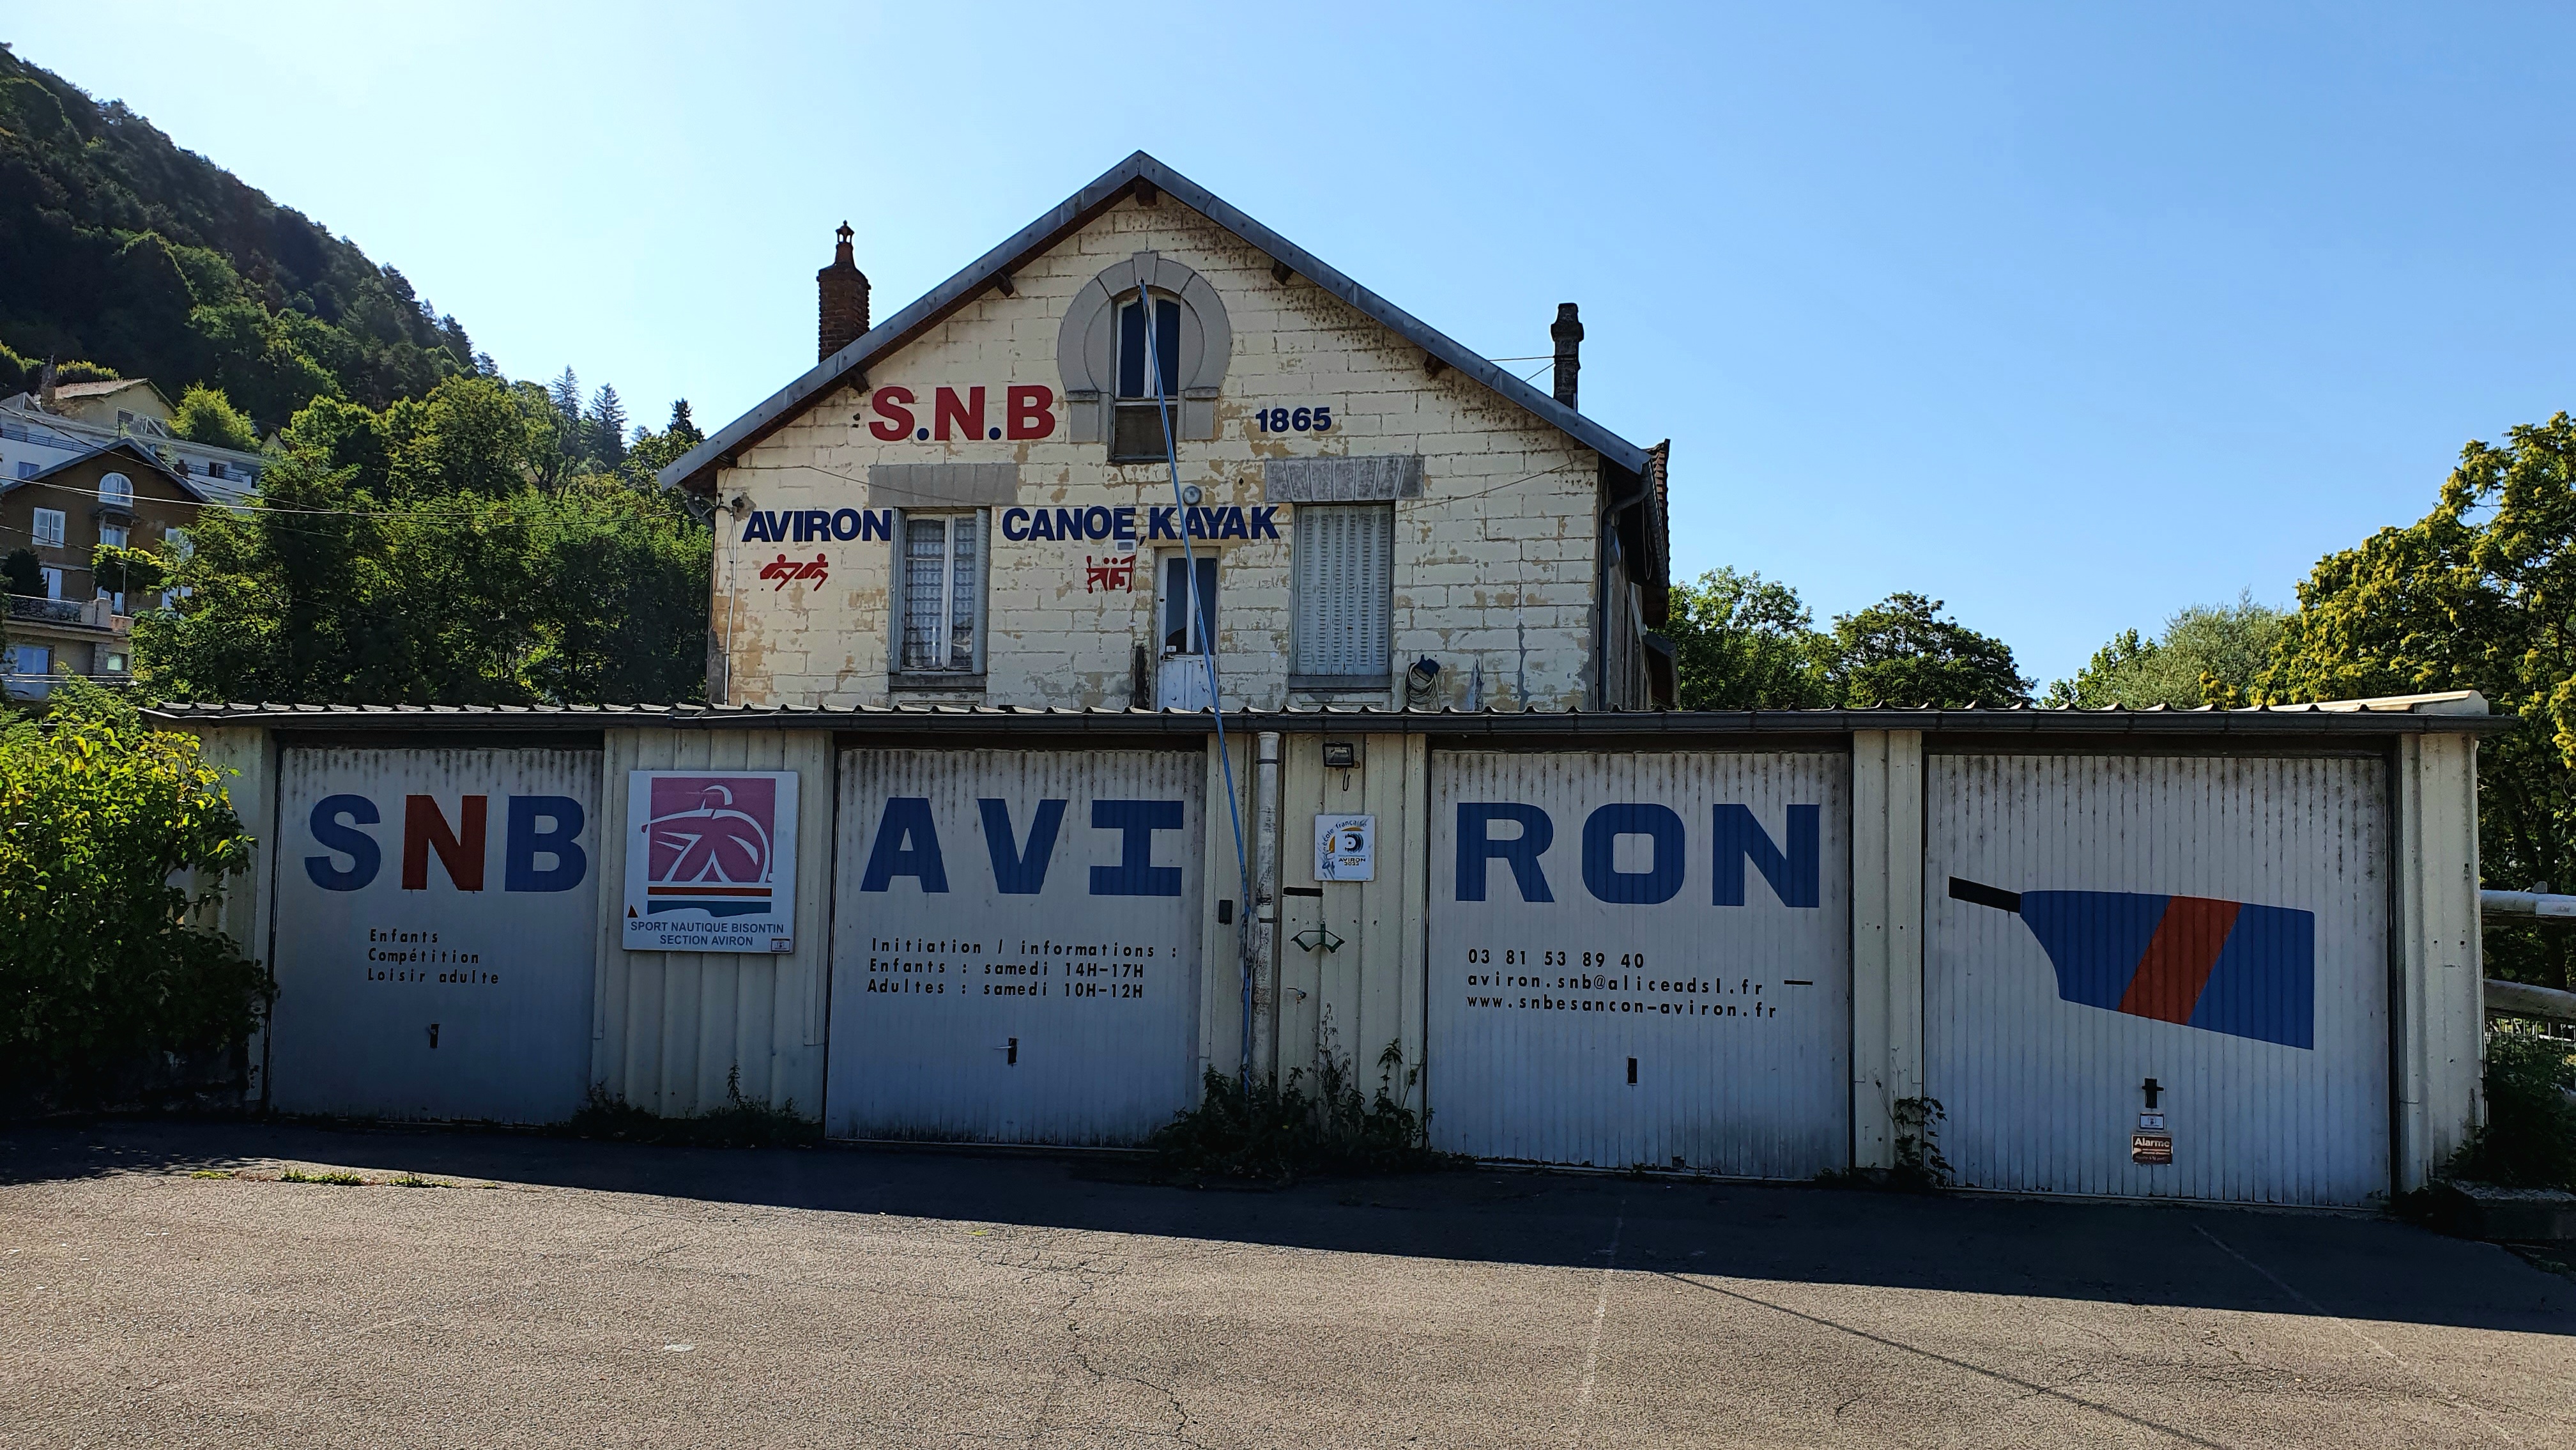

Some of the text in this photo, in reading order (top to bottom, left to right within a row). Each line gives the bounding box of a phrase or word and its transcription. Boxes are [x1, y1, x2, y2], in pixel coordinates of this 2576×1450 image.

[869, 385, 1055, 442] S.N.B
[1255, 406, 1332, 433] 1865
[741, 508, 893, 542] AVIRON
[370, 928, 438, 943] Enfants
[631, 922, 784, 934] SPORT NAUTIQUE BISONTIN
[660, 935, 753, 946] SECTION AVIRON
[872, 937, 981, 954] Initiation
[1021, 940, 1154, 957] informations
[368, 947, 479, 965] Compétition
[1468, 948, 1644, 968] 03 81 53 89 40
[367, 968, 499, 984] Loisir adulte
[870, 958, 946, 974] Enfants
[985, 960, 1048, 976] samedi
[1065, 962, 1144, 978] 14H-17H
[867, 978, 945, 994] Adultes
[983, 981, 1047, 996] samedi
[1065, 983, 1143, 999] 10H-12H
[1468, 971, 1763, 995] aviron.snb@aliceadsl.fr
[1467, 994, 1776, 1018] www.snbesancon-aviron.fr
[2134, 1137, 2170, 1148] Alarme
